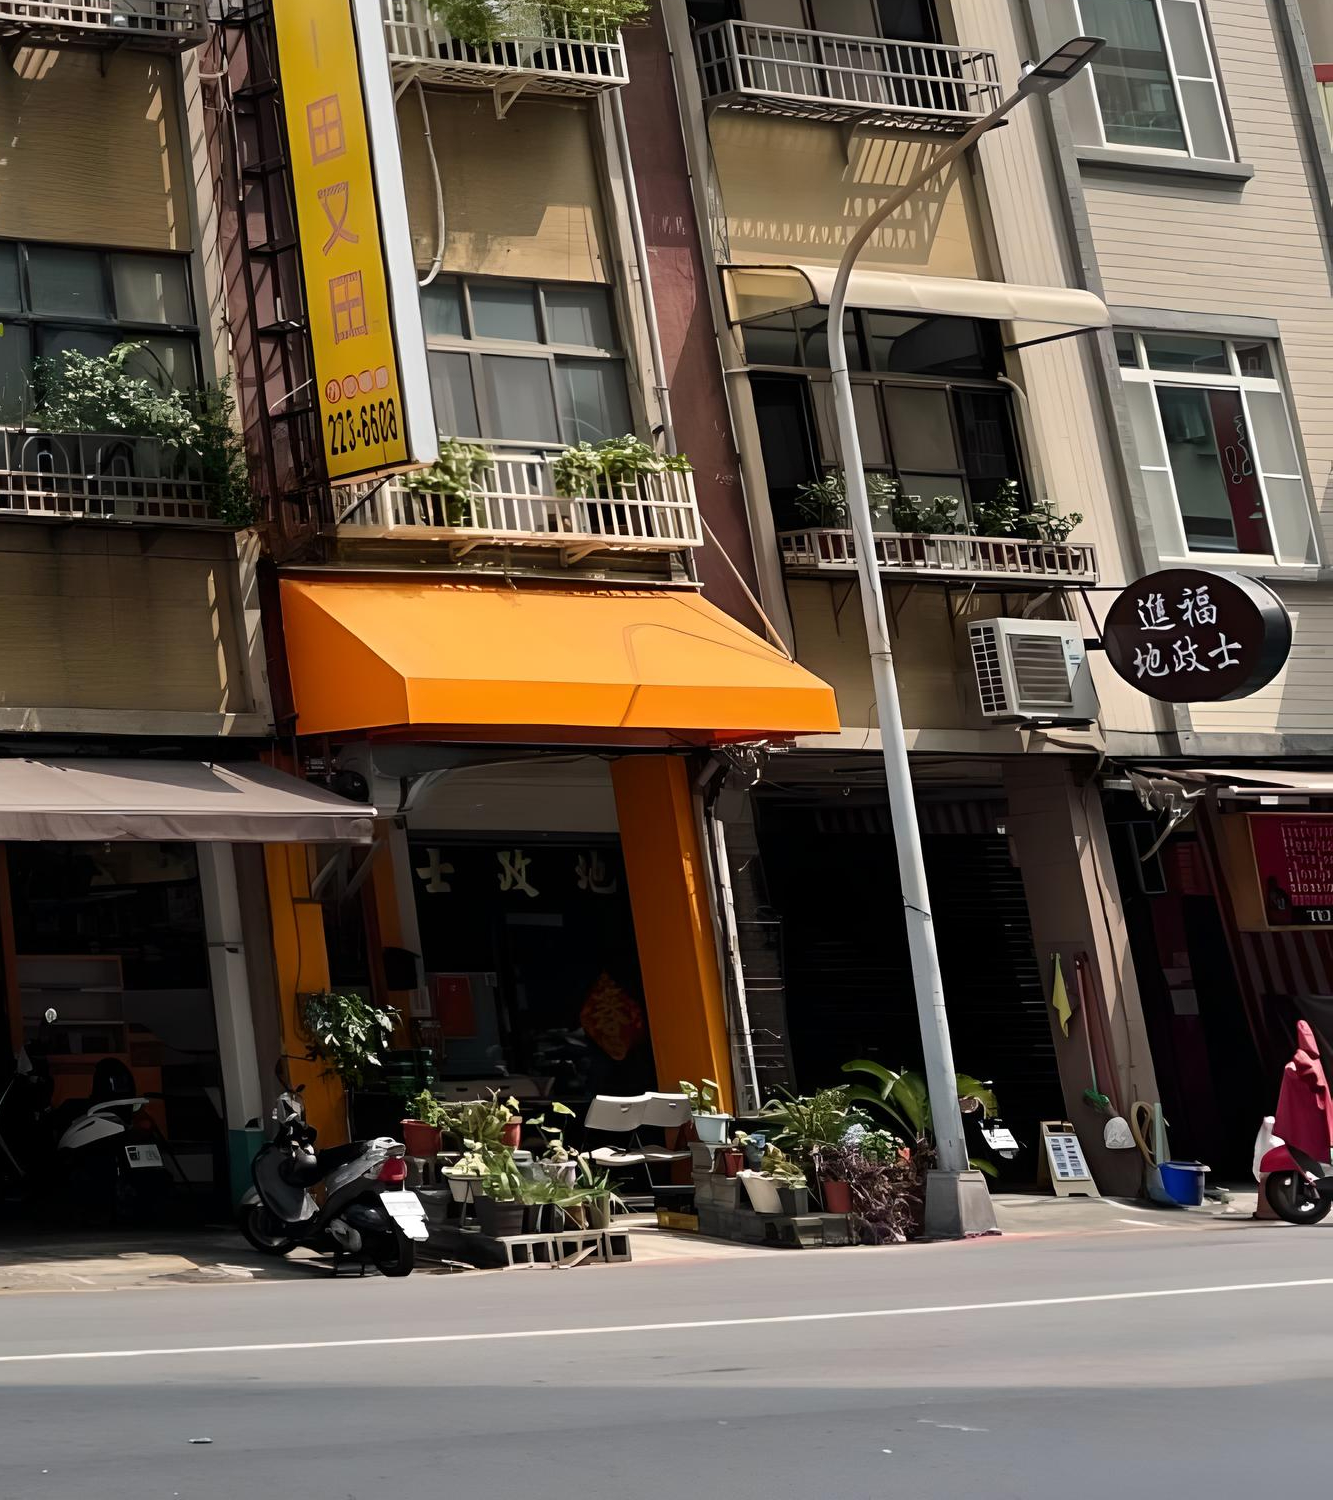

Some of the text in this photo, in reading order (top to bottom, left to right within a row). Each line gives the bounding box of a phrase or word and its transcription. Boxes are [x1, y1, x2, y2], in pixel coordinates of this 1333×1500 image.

[1137, 585, 1217, 631] 進福
[1132, 631, 1243, 680] 地政士
